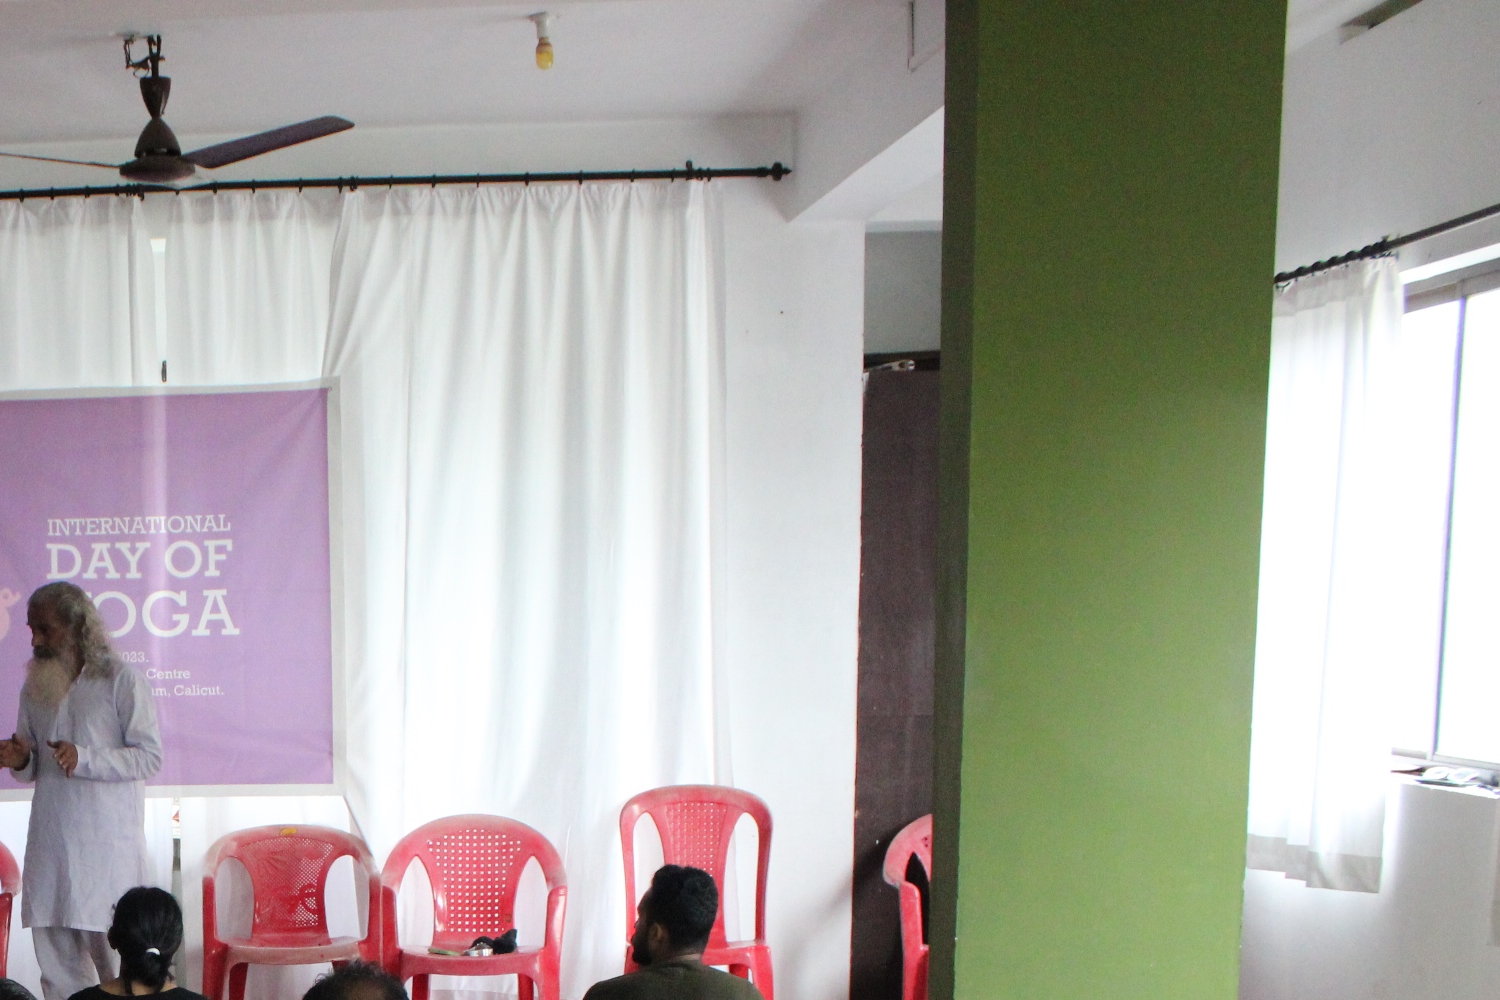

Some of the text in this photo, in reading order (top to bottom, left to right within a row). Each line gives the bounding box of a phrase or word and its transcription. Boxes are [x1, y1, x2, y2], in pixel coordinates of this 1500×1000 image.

[47, 514, 231, 536] INTERNATIONAL
[46, 539, 233, 579] DAY OF
[85, 589, 240, 638] OGA
[118, 651, 149, 663] 023.
[146, 668, 191, 680] Centre
[173, 684, 225, 697] Calicut.
